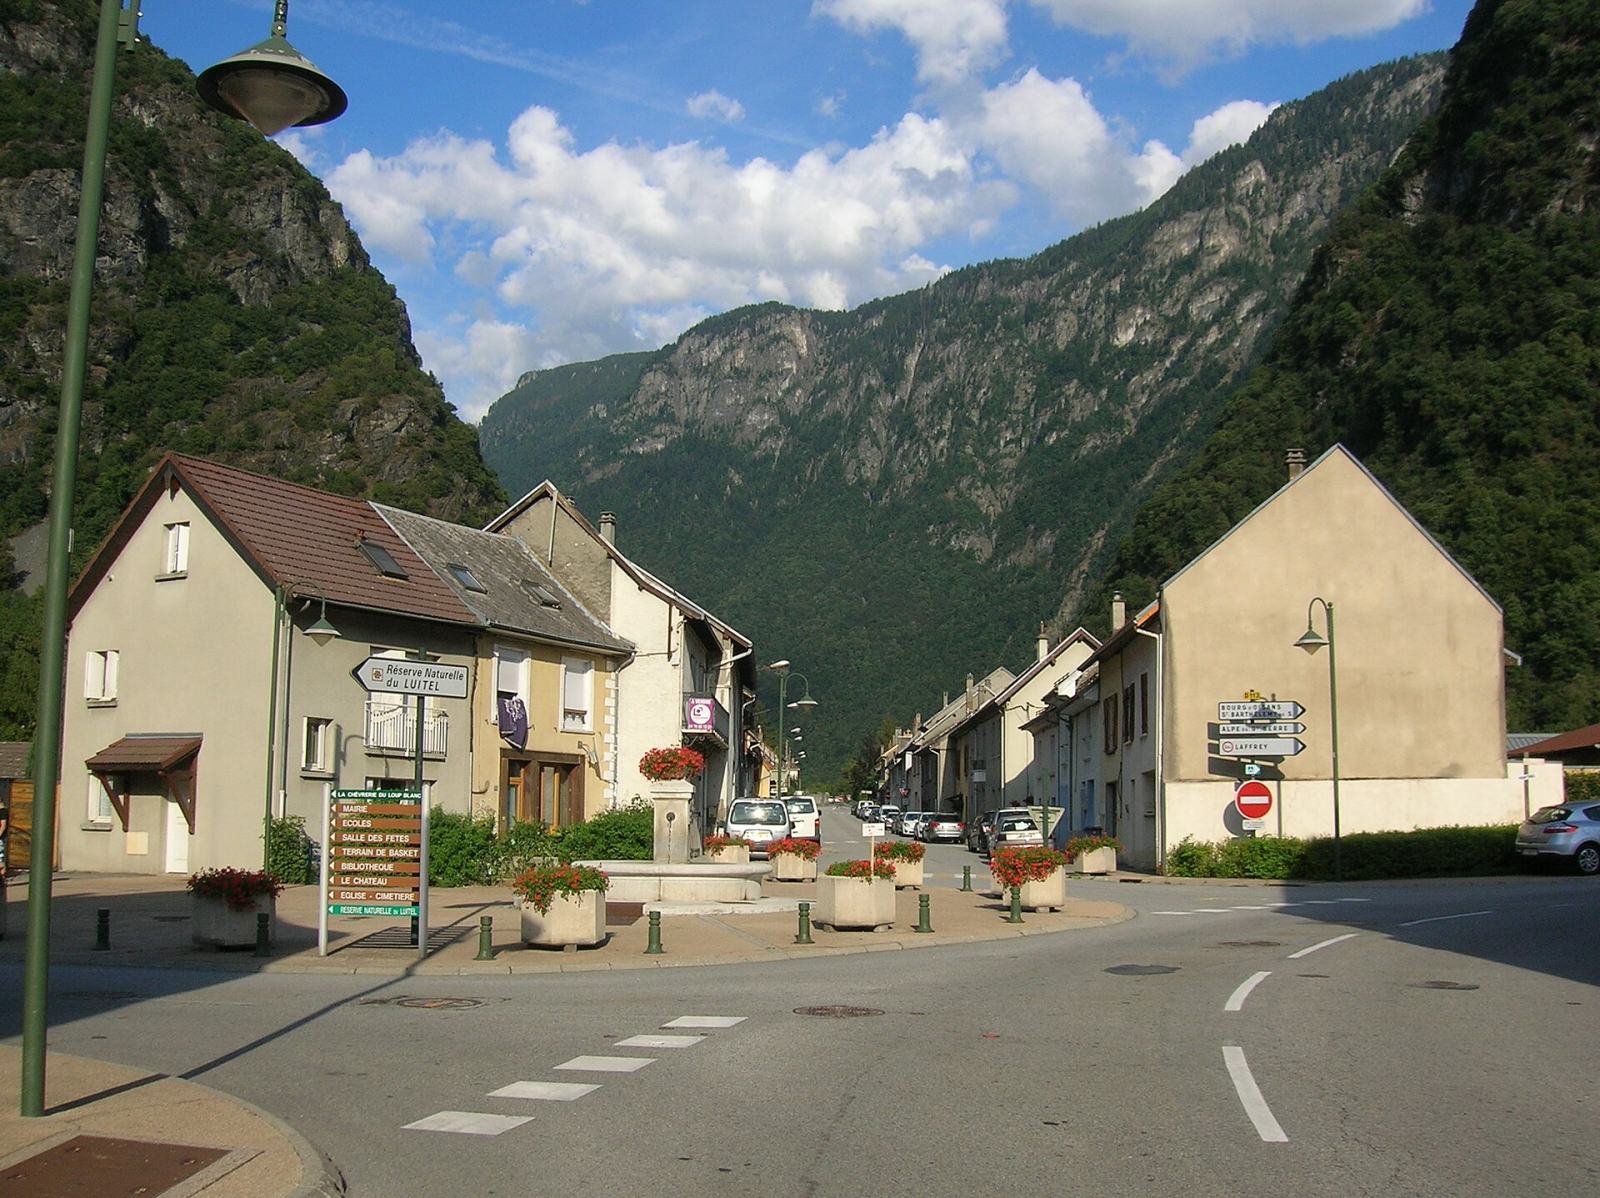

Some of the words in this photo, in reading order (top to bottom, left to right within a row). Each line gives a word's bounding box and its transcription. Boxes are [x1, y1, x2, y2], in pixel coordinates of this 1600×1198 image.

[386, 664, 422, 677] Réserve
[425, 667, 464, 681] Naturelle
[386, 678, 399, 688] du
[404, 679, 440, 691] LUITEL
[342, 805, 368, 813] MAIRIE
[342, 819, 372, 828] ECOLES
[342, 833, 365, 842] SALLE
[368, 834, 383, 842] DES
[385, 834, 410, 842] FETES
[342, 848, 373, 856] TERRAIN
[376, 848, 387, 856] DE
[389, 849, 419, 857] BASKET
[341, 862, 394, 871] BIBLIOTHEQUE
[341, 876, 351, 885] LE
[353, 877, 388, 885] CHATEAU
[340, 891, 367, 899] EGLISE
[375, 892, 415, 901] CIMETIERE
[340, 906, 363, 914] RESERVE
[363, 907, 392, 915] NATURELLE
[399, 908, 417, 916] LUITEL
